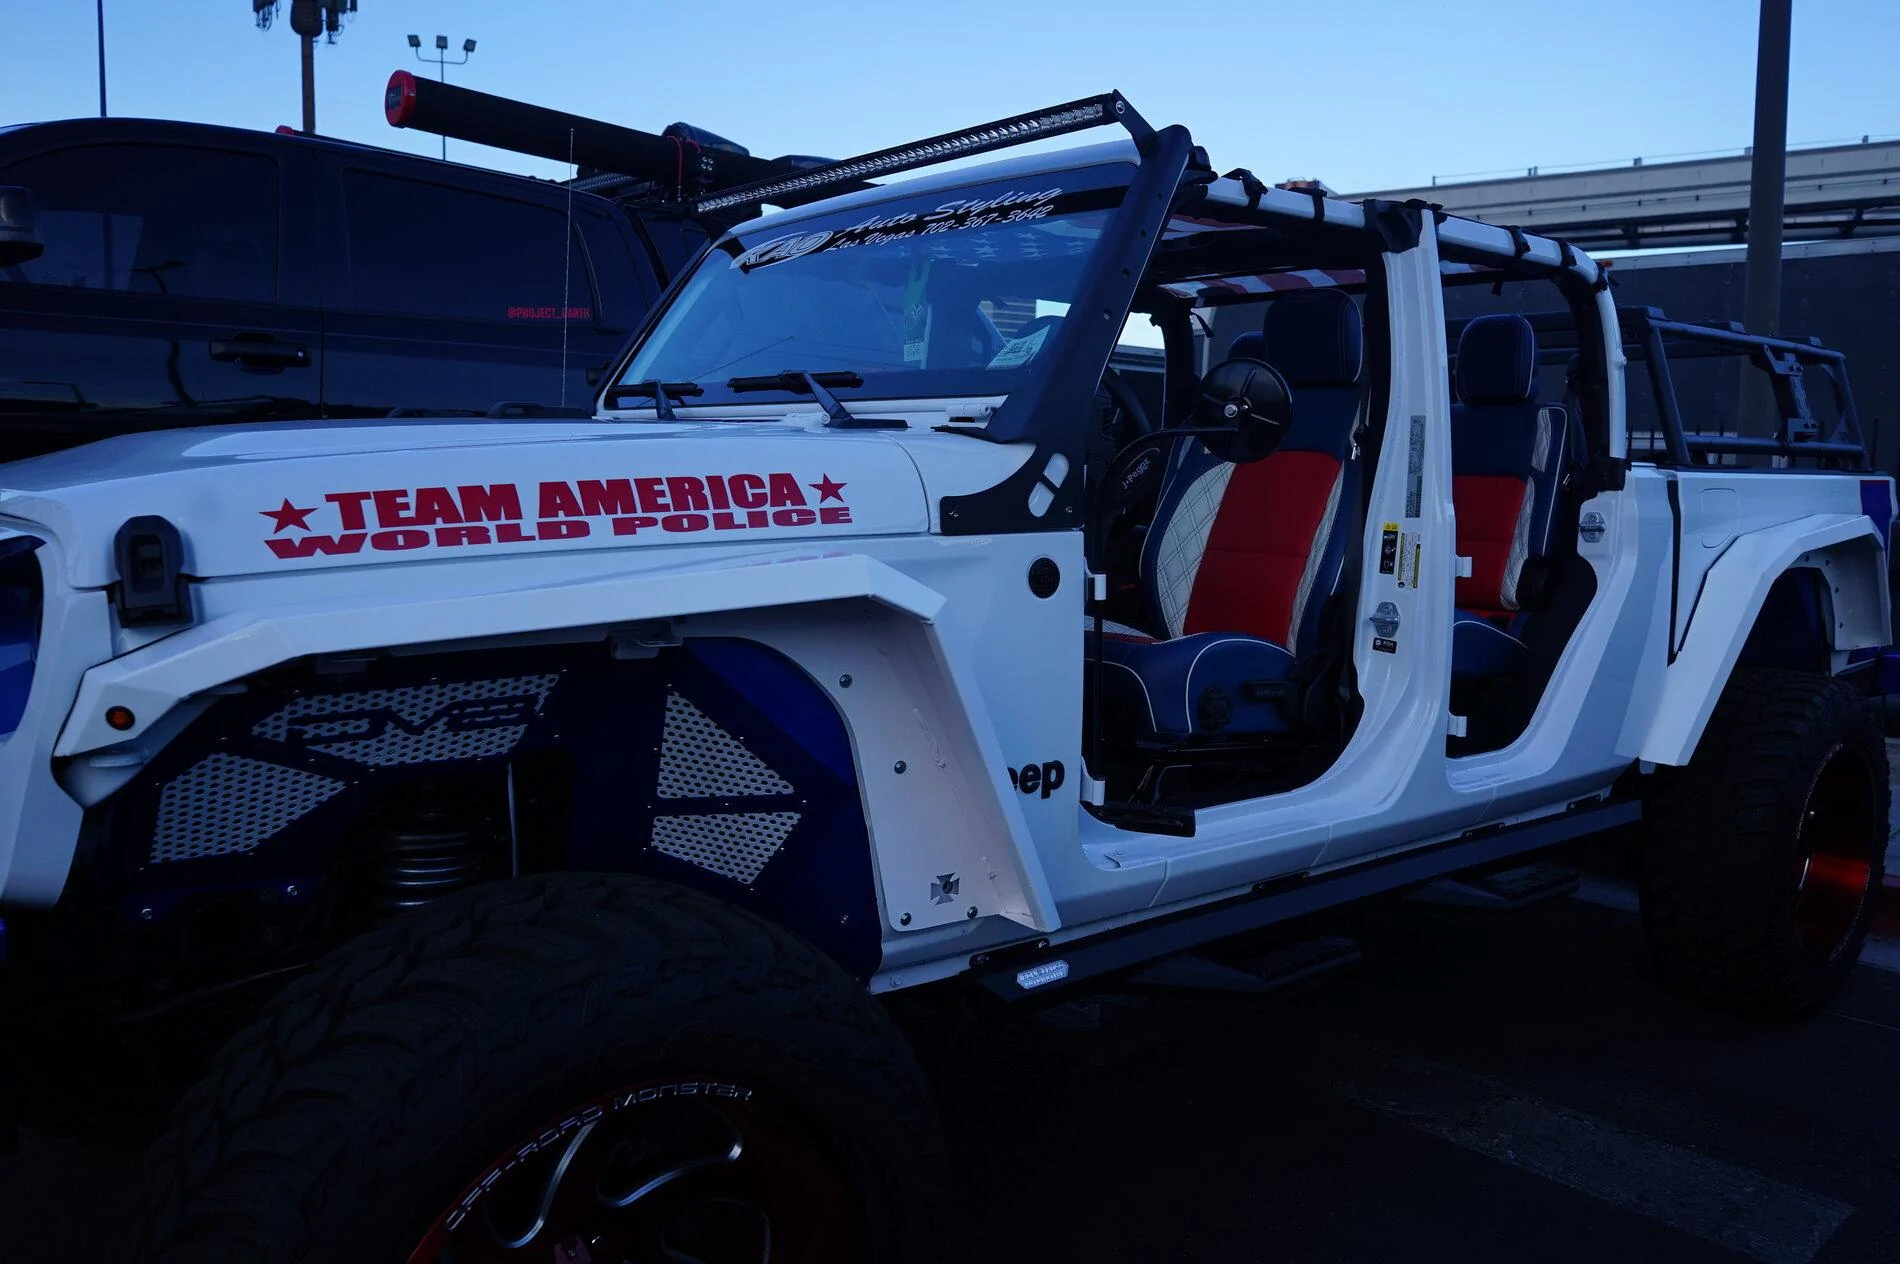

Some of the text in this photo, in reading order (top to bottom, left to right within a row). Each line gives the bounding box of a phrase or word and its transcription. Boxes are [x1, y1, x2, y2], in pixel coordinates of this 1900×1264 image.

[822, 204, 1055, 253] Las Vegas 702-367-3642
[834, 187, 1064, 239] Auto Styling
[324, 472, 808, 531] TEAM AMERICA
[264, 506, 853, 559] WORLD POLICE
[611, 1081, 753, 1112] MONSTER
